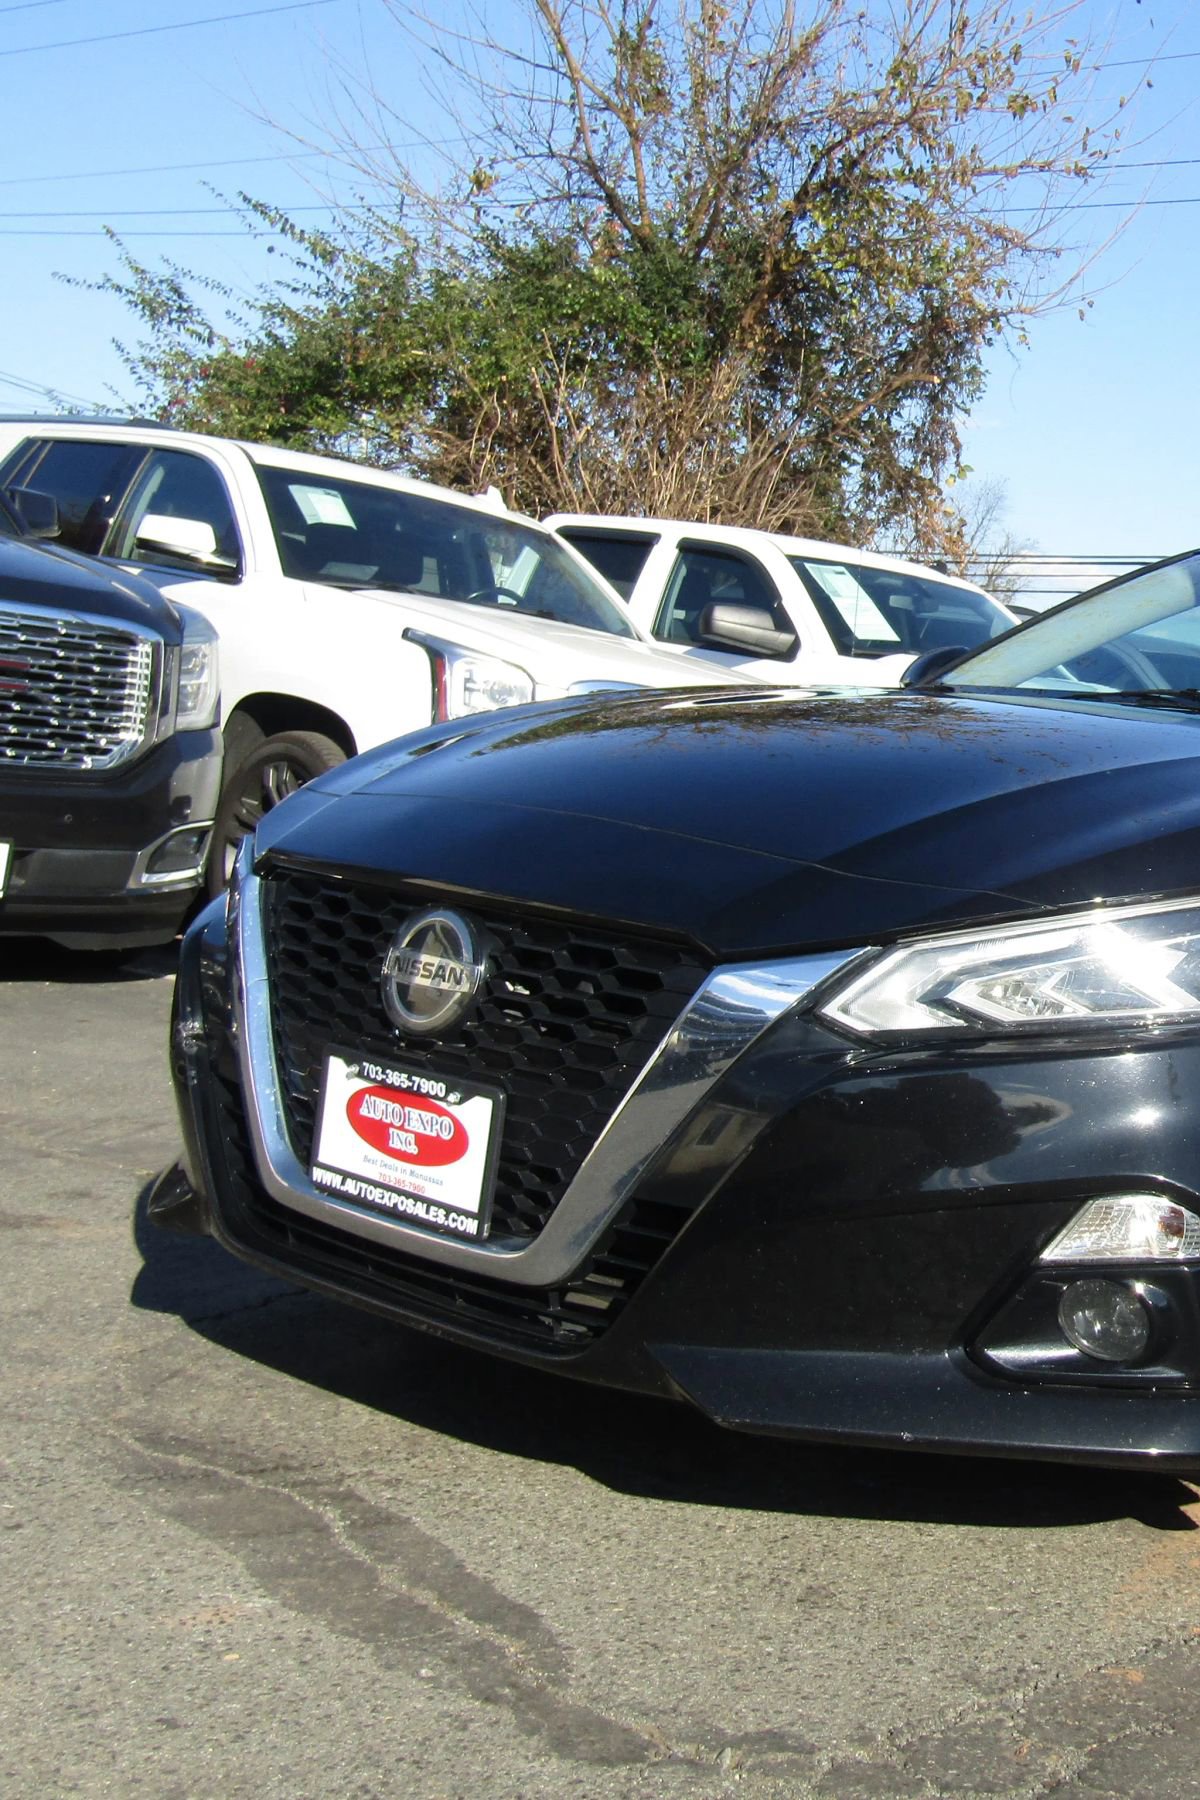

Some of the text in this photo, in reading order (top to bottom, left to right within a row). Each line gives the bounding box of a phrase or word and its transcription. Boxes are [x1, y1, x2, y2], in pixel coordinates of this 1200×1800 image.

[392, 954, 464, 985] NISSAN
[362, 1062, 446, 1098] 703-365-7900
[360, 1093, 455, 1140] AUTO EXPO
[388, 1127, 419, 1155] INC.
[363, 1154, 378, 1167] Best
[379, 1159, 399, 1172] Deals
[400, 1167, 408, 1176] in
[378, 1172, 426, 1194] 703-365-7900
[312, 1166, 479, 1236] WWW.AUTOEXPOSALES.COM
